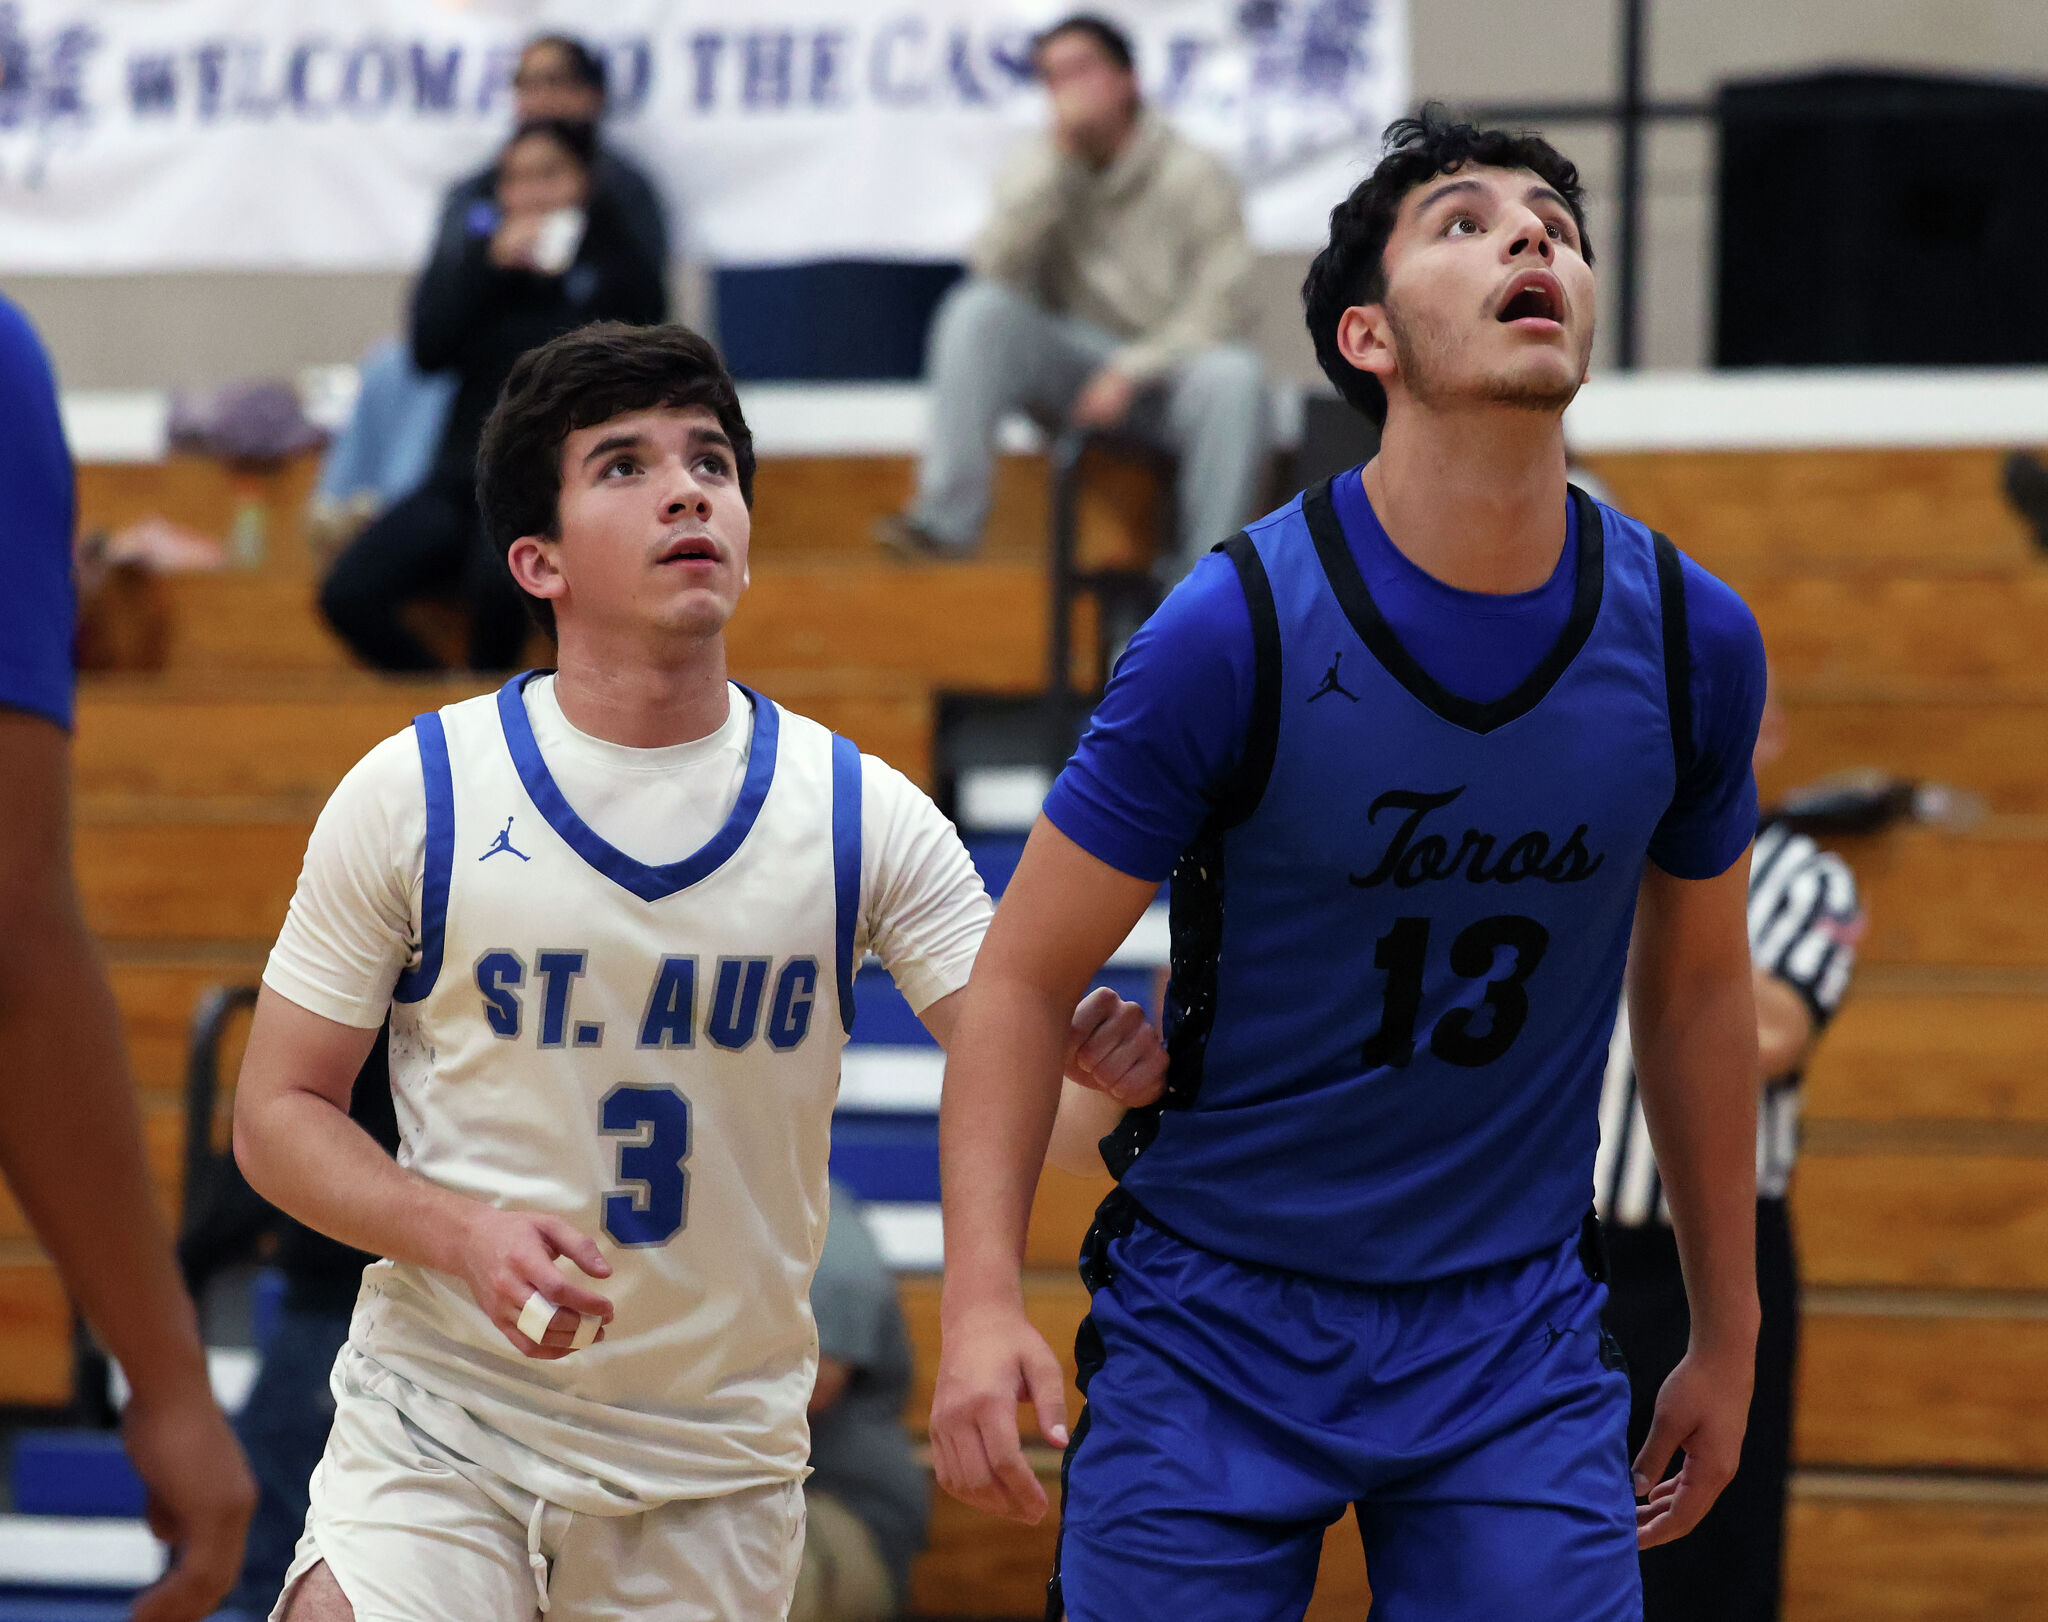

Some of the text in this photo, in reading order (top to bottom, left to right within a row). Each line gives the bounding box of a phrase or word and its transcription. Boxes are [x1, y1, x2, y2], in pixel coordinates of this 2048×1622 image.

[690, 31, 850, 113] THE
[1349, 784, 1604, 888] Toros
[472, 947, 820, 1054] ST. AUG
[1360, 914, 1550, 1068] 13
[597, 1081, 693, 1249] 3
